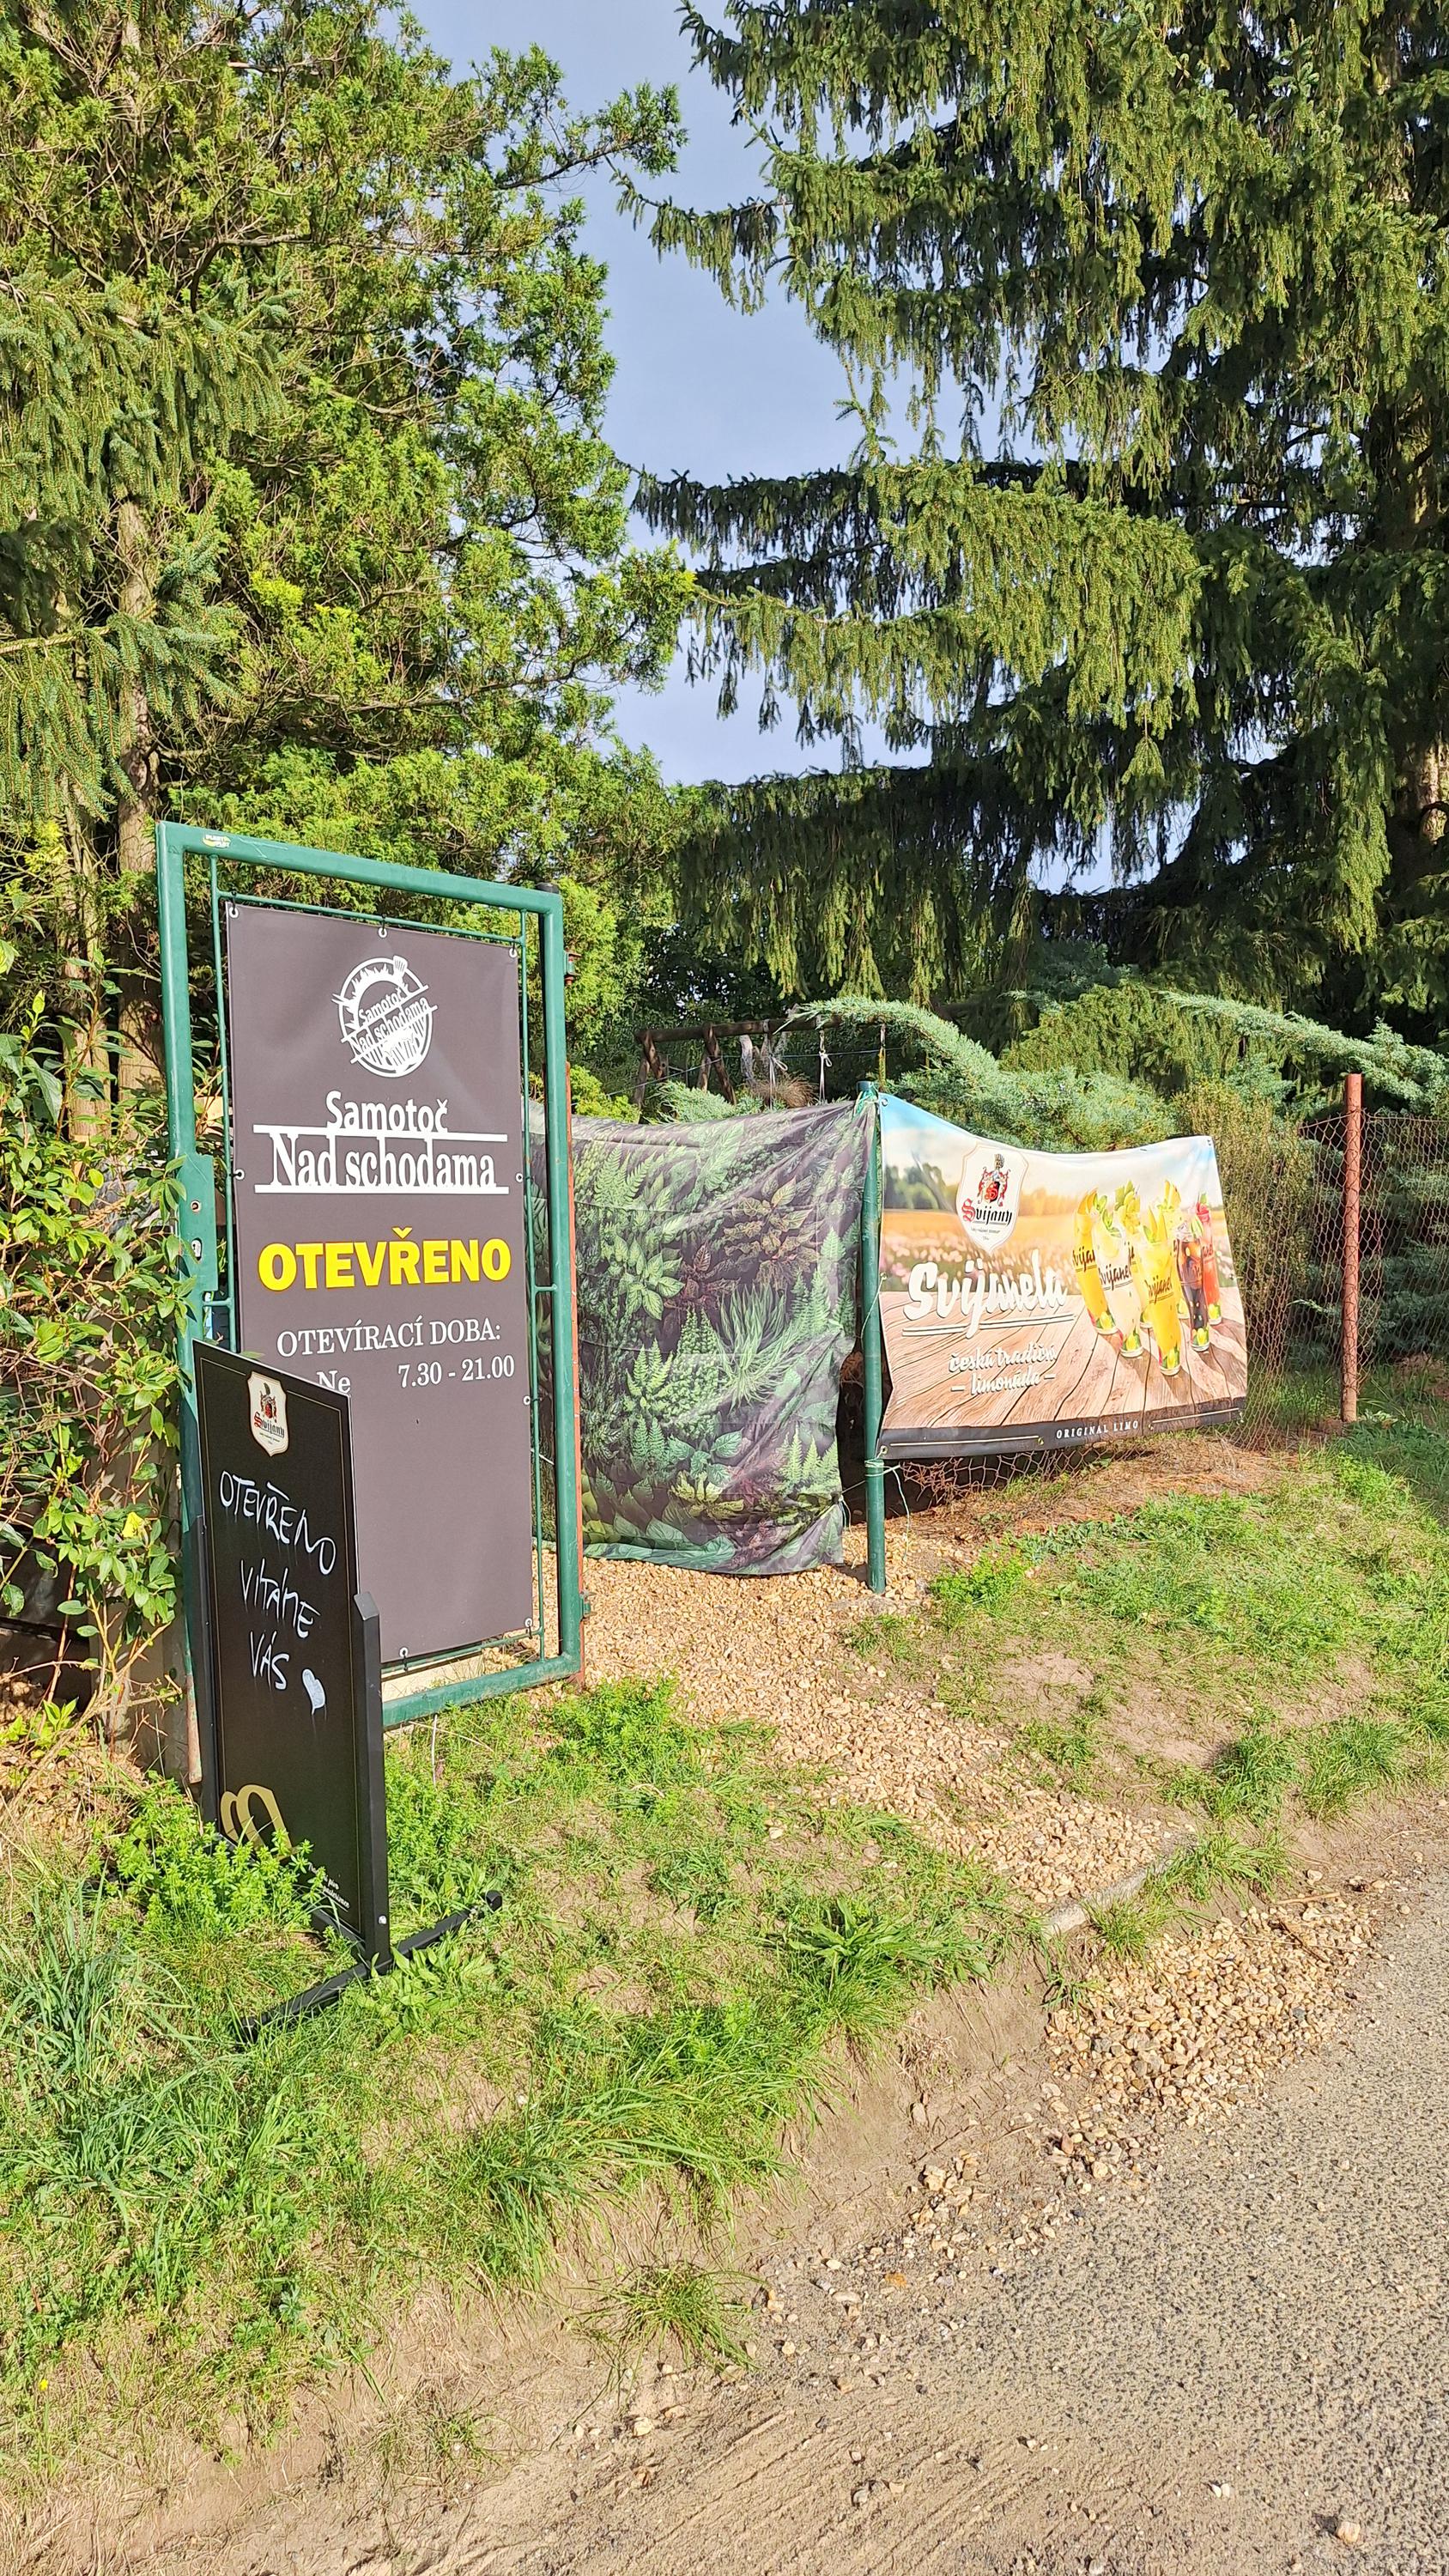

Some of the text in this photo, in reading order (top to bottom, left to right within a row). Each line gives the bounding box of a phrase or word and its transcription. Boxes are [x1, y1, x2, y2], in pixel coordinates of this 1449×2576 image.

[347, 997, 431, 1058] Nad schodama
[358, 986, 405, 1026] Samotoč
[325, 1090, 448, 1133] Samotoč
[267, 1132, 497, 1188] Nad schodama
[961, 1198, 1013, 1226] Svijany
[258, 1226, 512, 1291] OTEVŘENO
[903, 1249, 1068, 1340] Svijanela
[276, 1315, 501, 1358] OTEVÍRACÍ DOBA:
[316, 1370, 351, 1394] Ne
[398, 1363, 442, 1388] 7.30
[461, 1355, 515, 1382] 21.00
[971, 1365, 1041, 1396] limonáda
[1056, 1420, 1139, 1439] ORIGINAL LIMO
[220, 1470, 336, 1576] OTEVŘENO
[250, 1631, 290, 1692] VÁS
